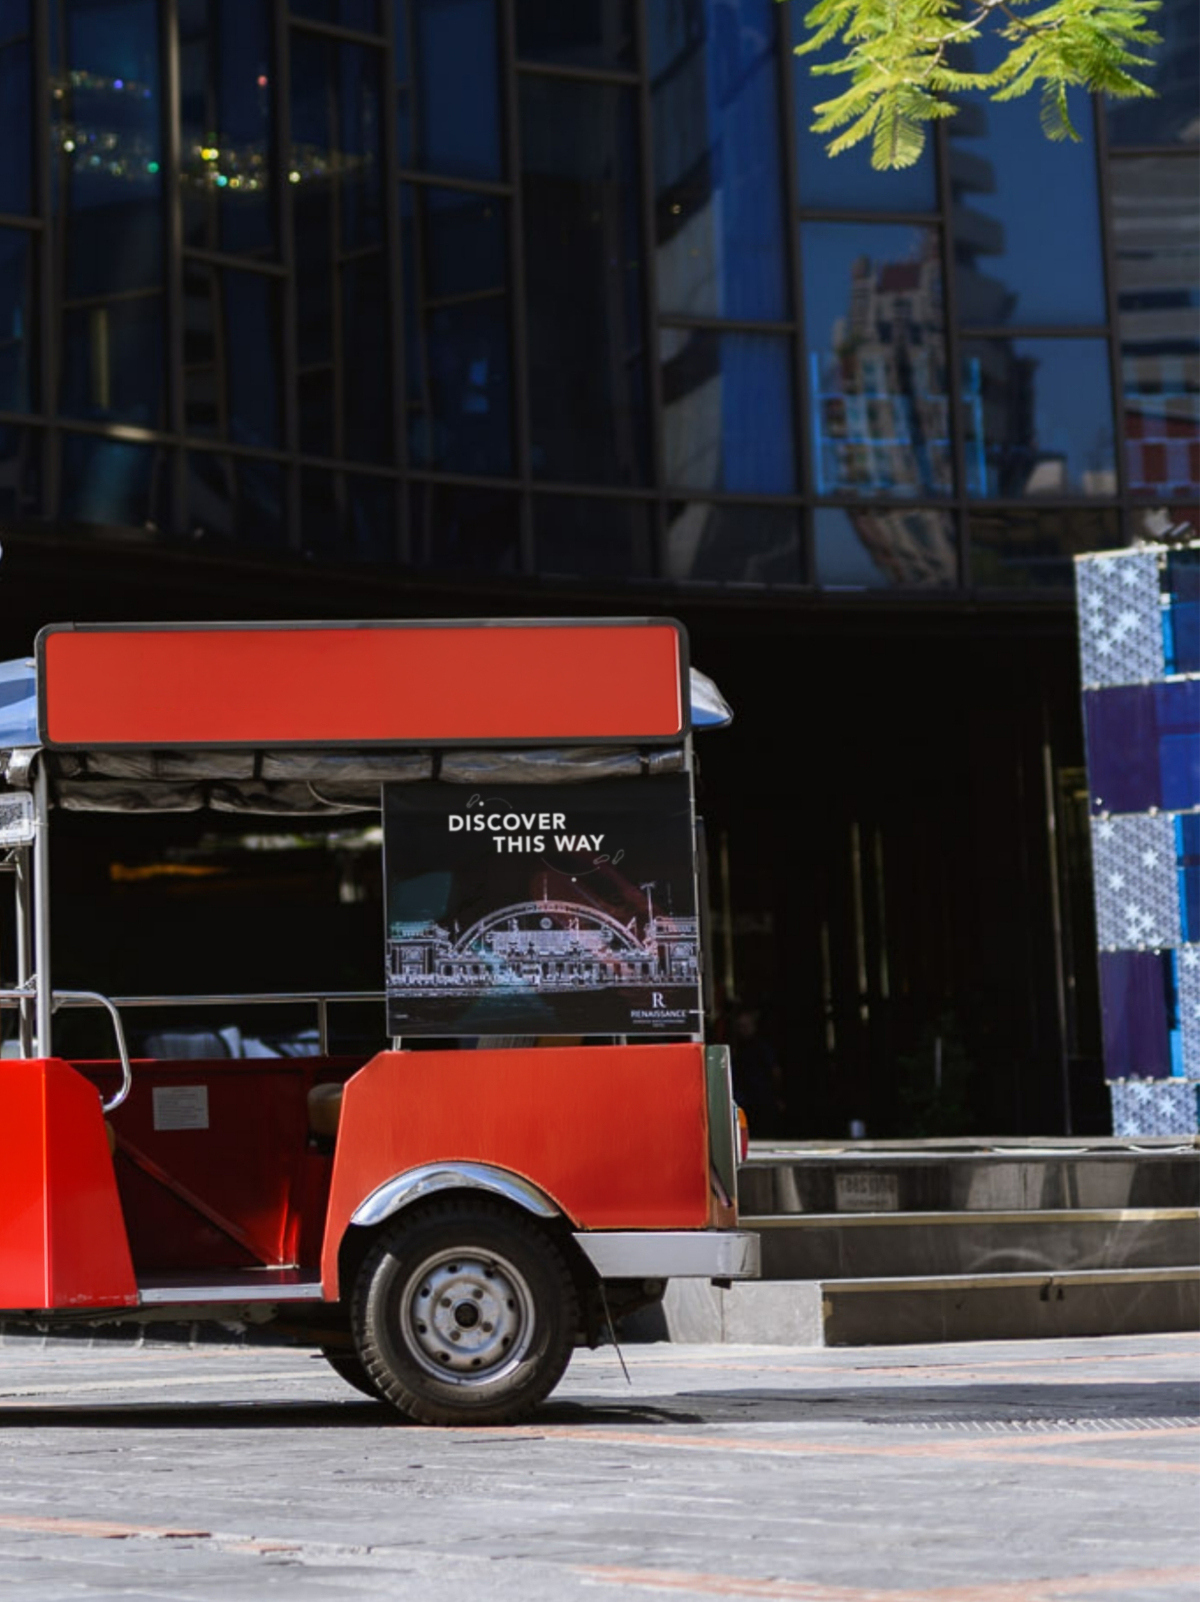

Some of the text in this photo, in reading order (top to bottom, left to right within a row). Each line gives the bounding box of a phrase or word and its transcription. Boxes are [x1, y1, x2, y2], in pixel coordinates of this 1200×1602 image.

[448, 812, 567, 832] DISCOVER
[492, 834, 605, 853] THIS WAY
[651, 991, 667, 1008] R
[630, 1009, 686, 1018] RENAISSANCE
